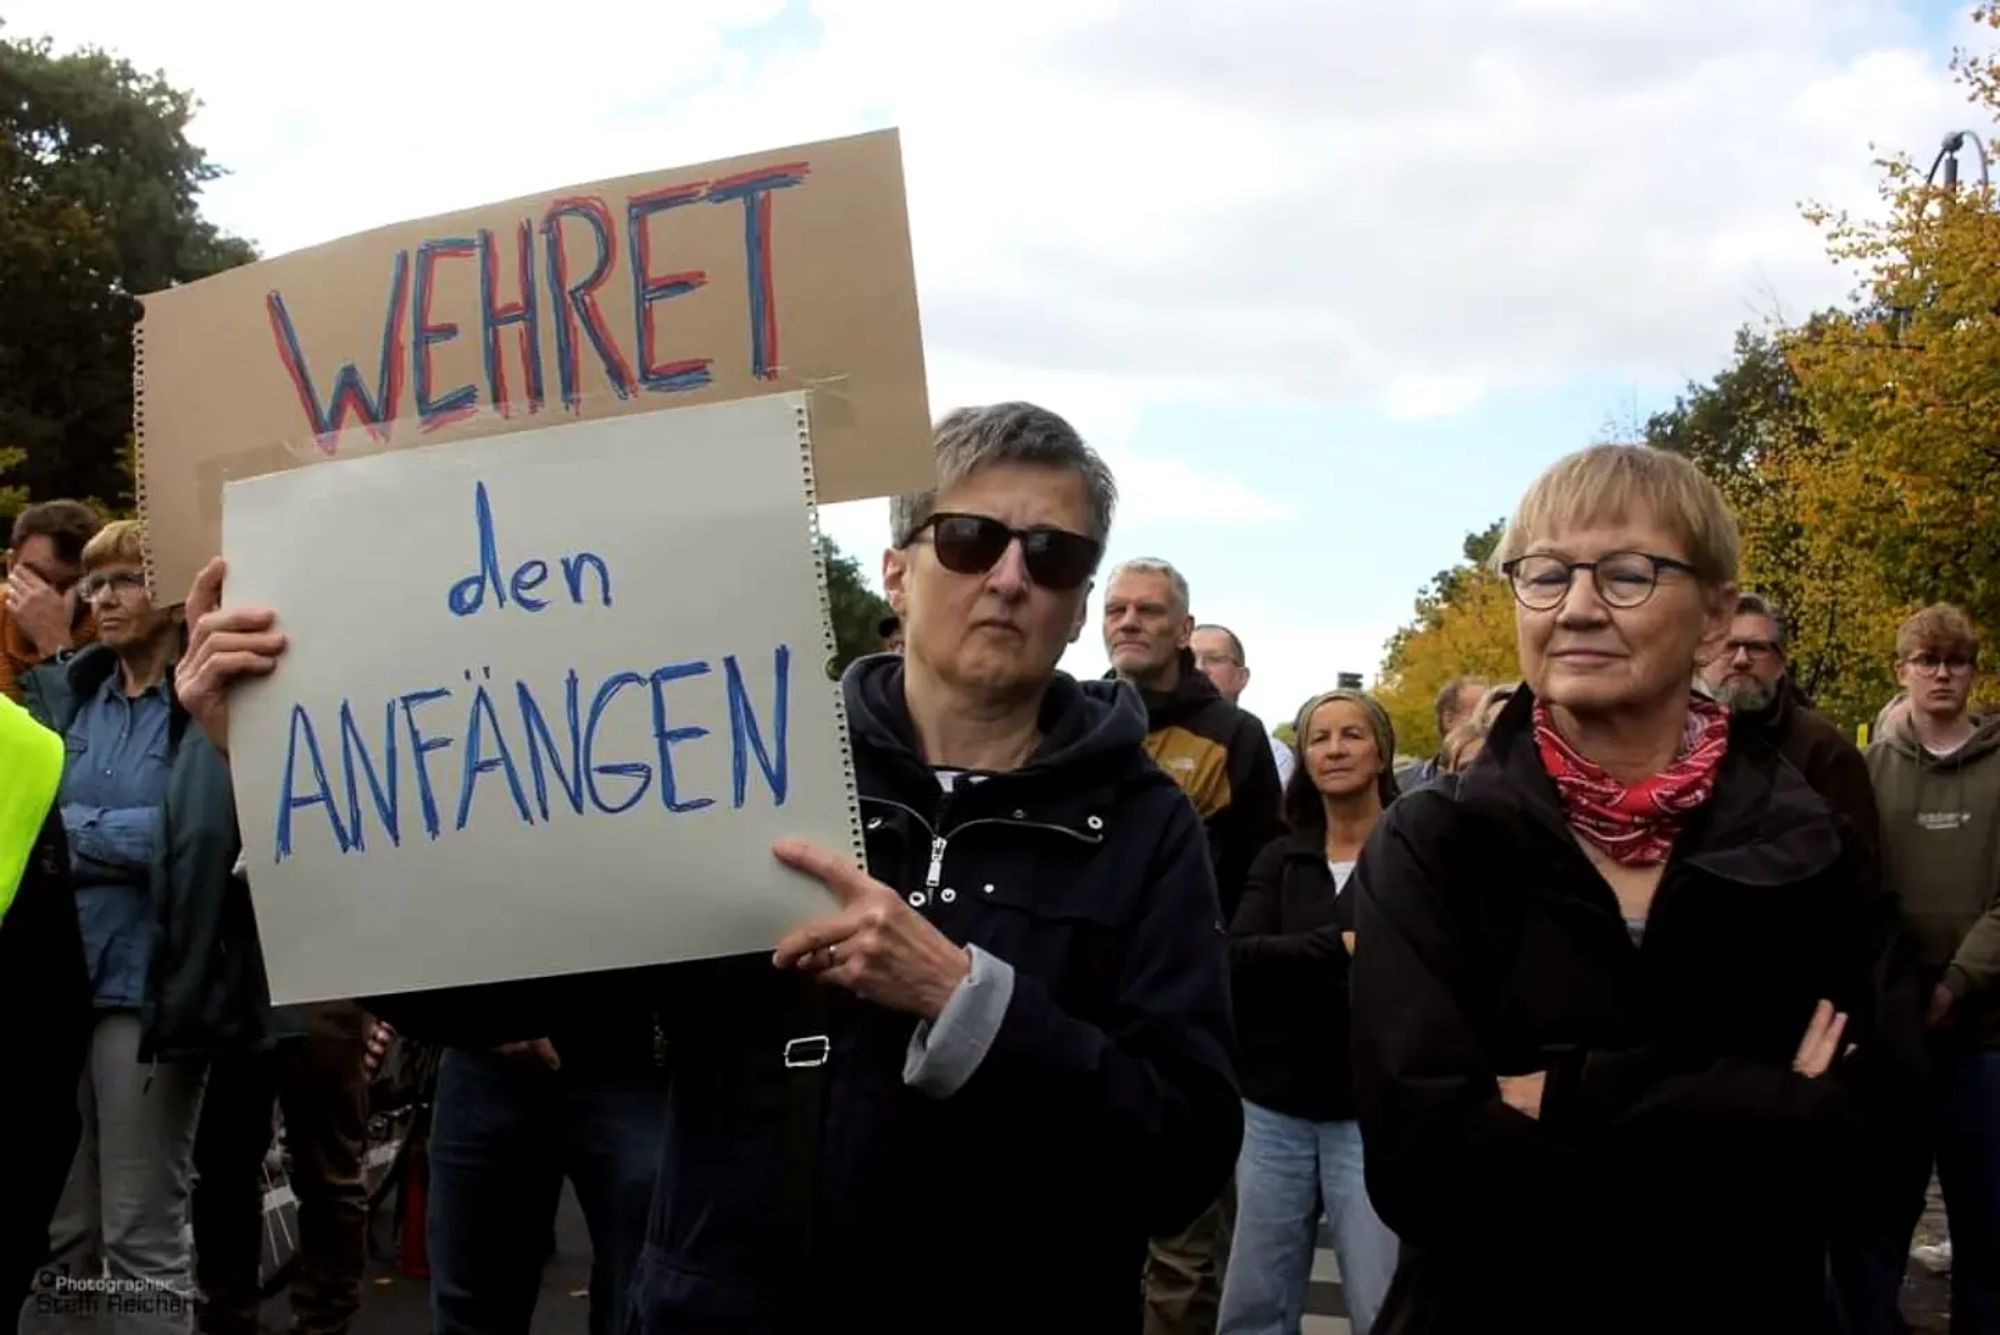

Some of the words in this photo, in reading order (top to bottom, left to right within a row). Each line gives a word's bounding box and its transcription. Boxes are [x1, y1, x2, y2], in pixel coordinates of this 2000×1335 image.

[267, 161, 810, 455] WEHRET
[448, 481, 612, 616] den
[275, 644, 790, 864] ANFÄNGEN
